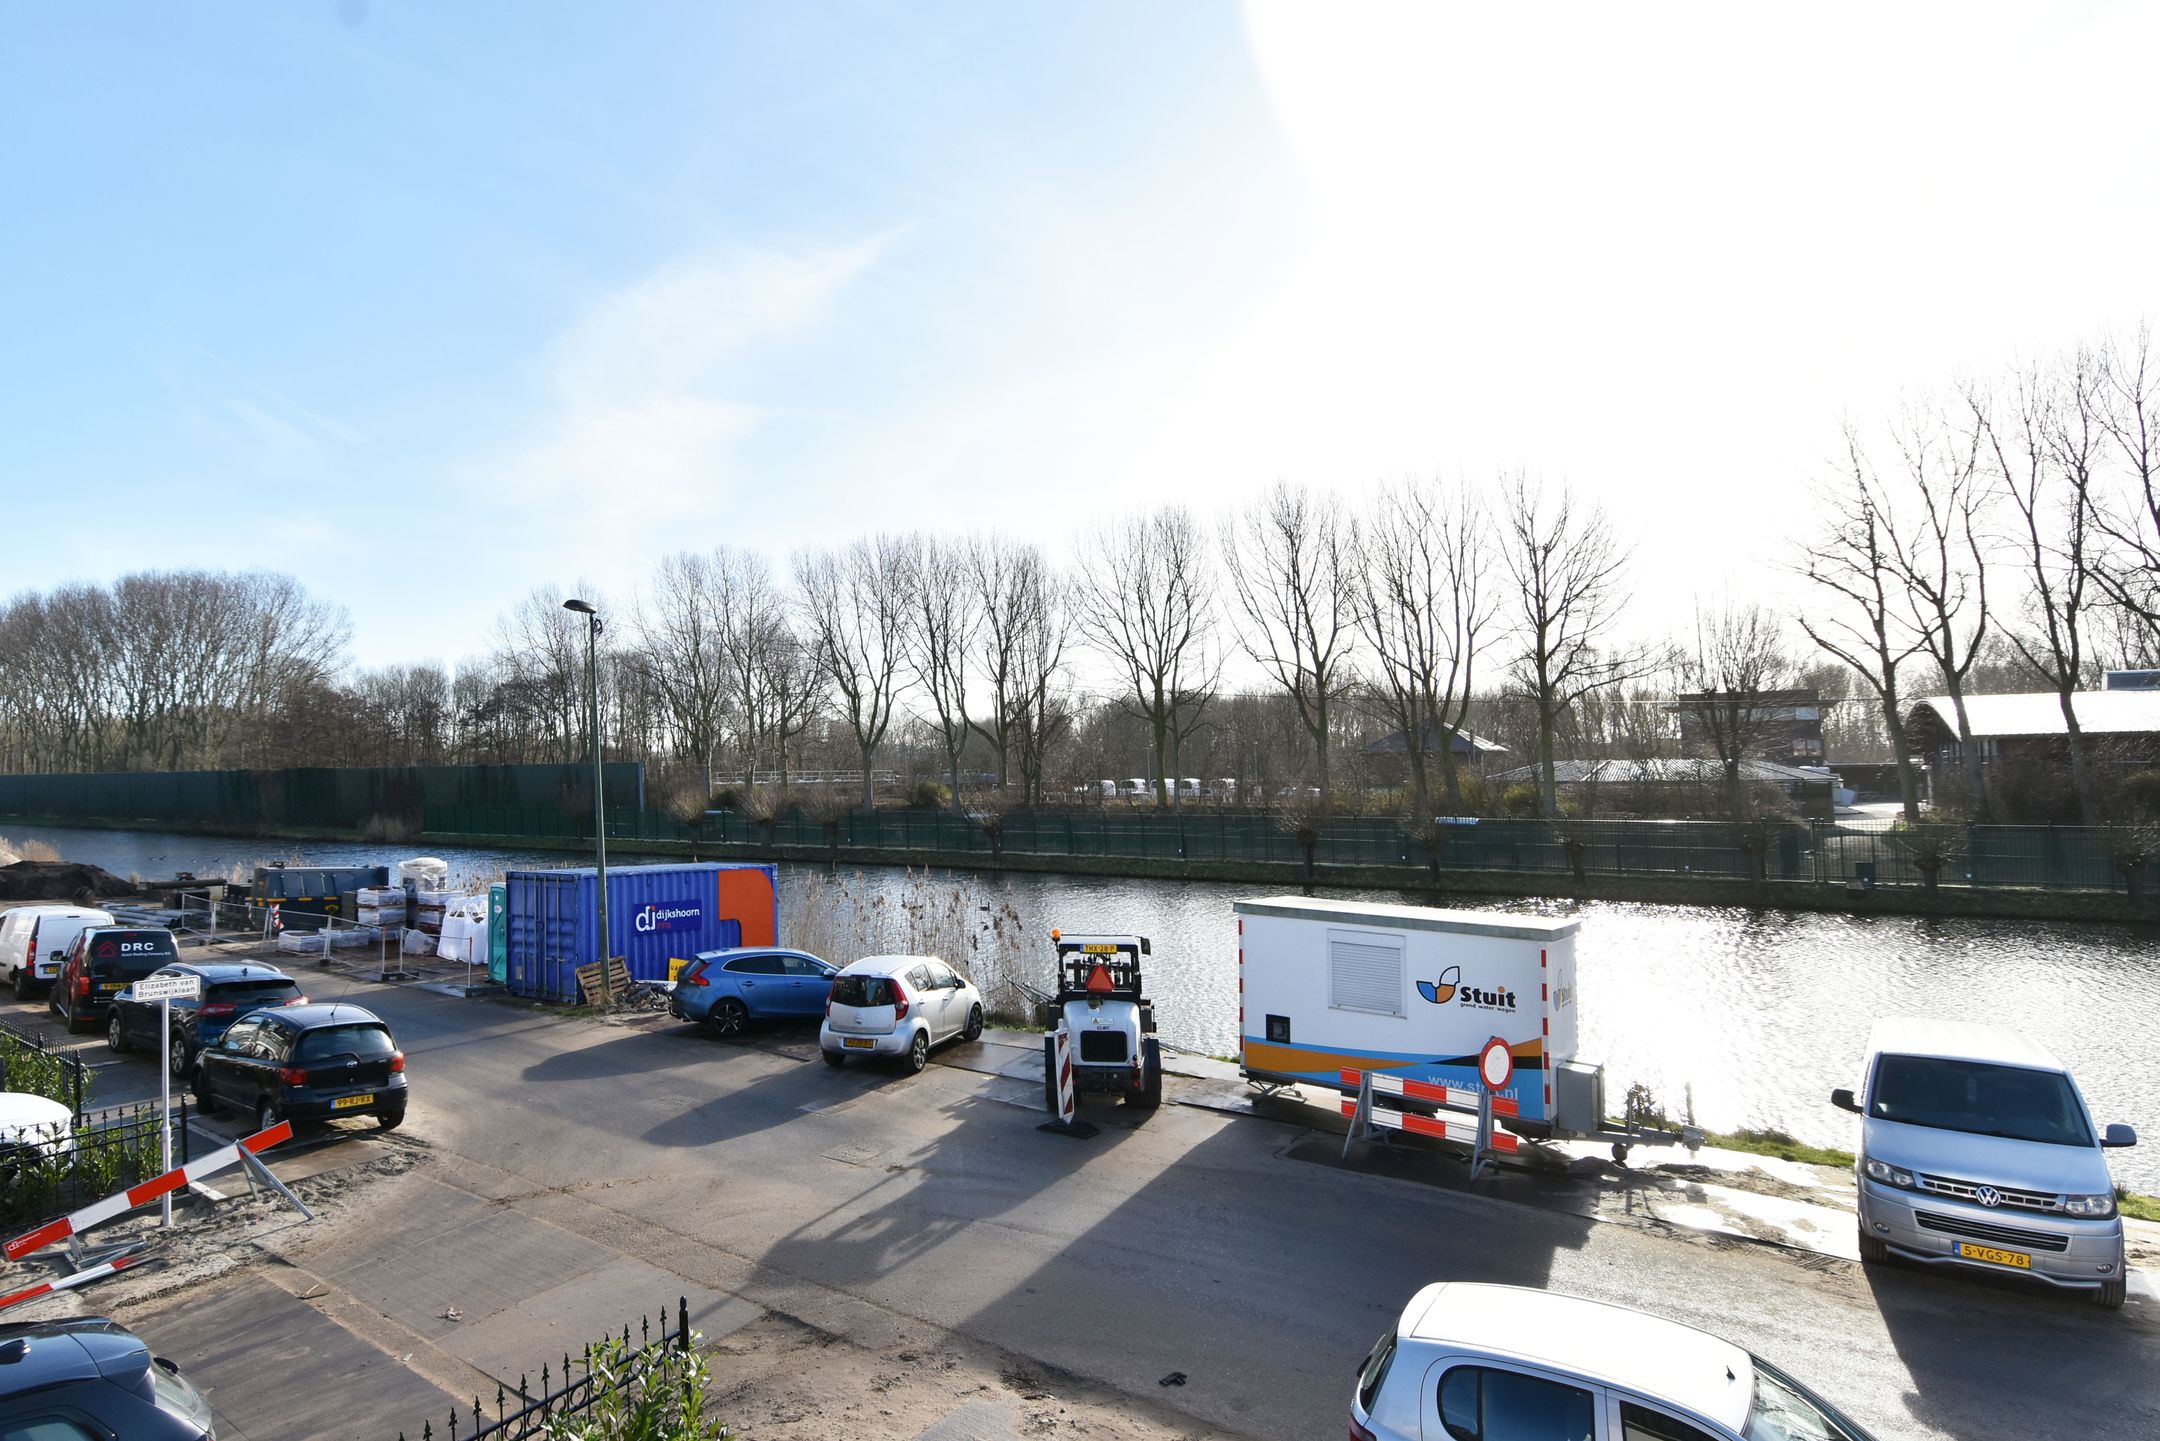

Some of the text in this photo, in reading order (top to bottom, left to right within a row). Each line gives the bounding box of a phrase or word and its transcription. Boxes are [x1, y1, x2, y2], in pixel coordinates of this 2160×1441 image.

[656, 909, 700, 921] dijkshoorn
[121, 942, 154, 952] DRC
[140, 981, 177, 990] Elizabeth
[138, 987, 195, 998] Brunswijklaan
[1460, 986, 1516, 1008] Stuit
[1427, 1076, 1518, 1100] www.st.nl
[1964, 1245, 2024, 1266] 5-VGS-78
